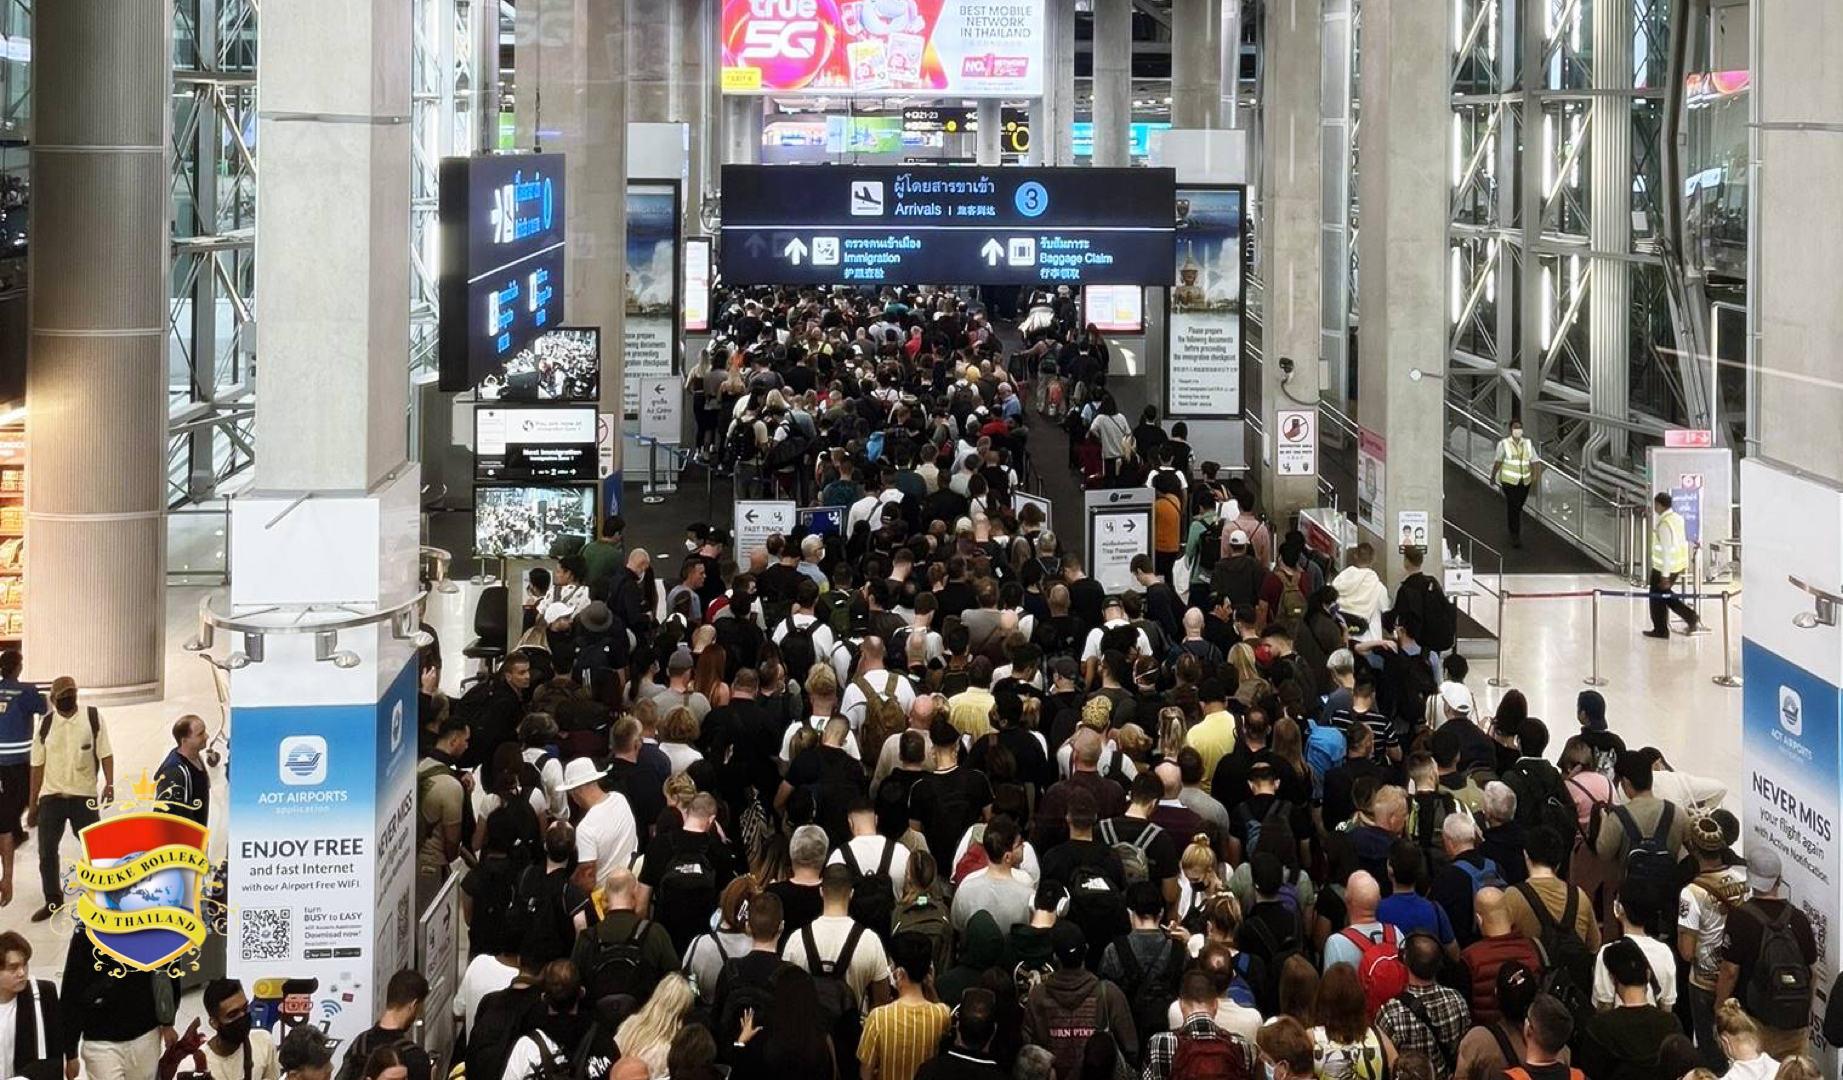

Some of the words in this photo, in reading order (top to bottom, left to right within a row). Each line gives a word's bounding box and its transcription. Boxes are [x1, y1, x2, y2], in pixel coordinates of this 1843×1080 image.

[750, 0, 817, 18] true
[960, 6, 986, 16] BEST
[989, 6, 1033, 16] MOBILE
[966, 17, 1025, 27] NETWORK
[741, 20, 818, 58] 5G
[960, 28, 972, 38] IN
[976, 28, 1031, 38] THAILAND
[894, 173, 995, 198] ผู้โดยสารขาเข้า
[1024, 188, 1039, 210] 3
[894, 202, 942, 216] Arrivals
[844, 252, 901, 266] Immigration
[1040, 252, 1083, 266] Baggage
[1085, 252, 1114, 264] Claim
[258, 792, 285, 804] AOT
[287, 790, 348, 803] AIRPORTS
[1753, 770, 1797, 819] NEVER
[1800, 801, 1831, 841] MISS
[1760, 807, 1779, 826] your
[1780, 817, 1801, 843] flight
[1802, 836, 1825, 860] again
[242, 840, 309, 859] ENJOY
[313, 838, 364, 856] FREE
[249, 864, 273, 876] and
[276, 863, 299, 875] fast
[302, 863, 355, 875] Internet
[242, 882, 262, 892] with
[280, 881, 314, 892] Airport
[315, 881, 336, 889] Free
[304, 913, 327, 921] BUSY
[340, 912, 363, 921] EASY
[304, 931, 342, 939] Download
